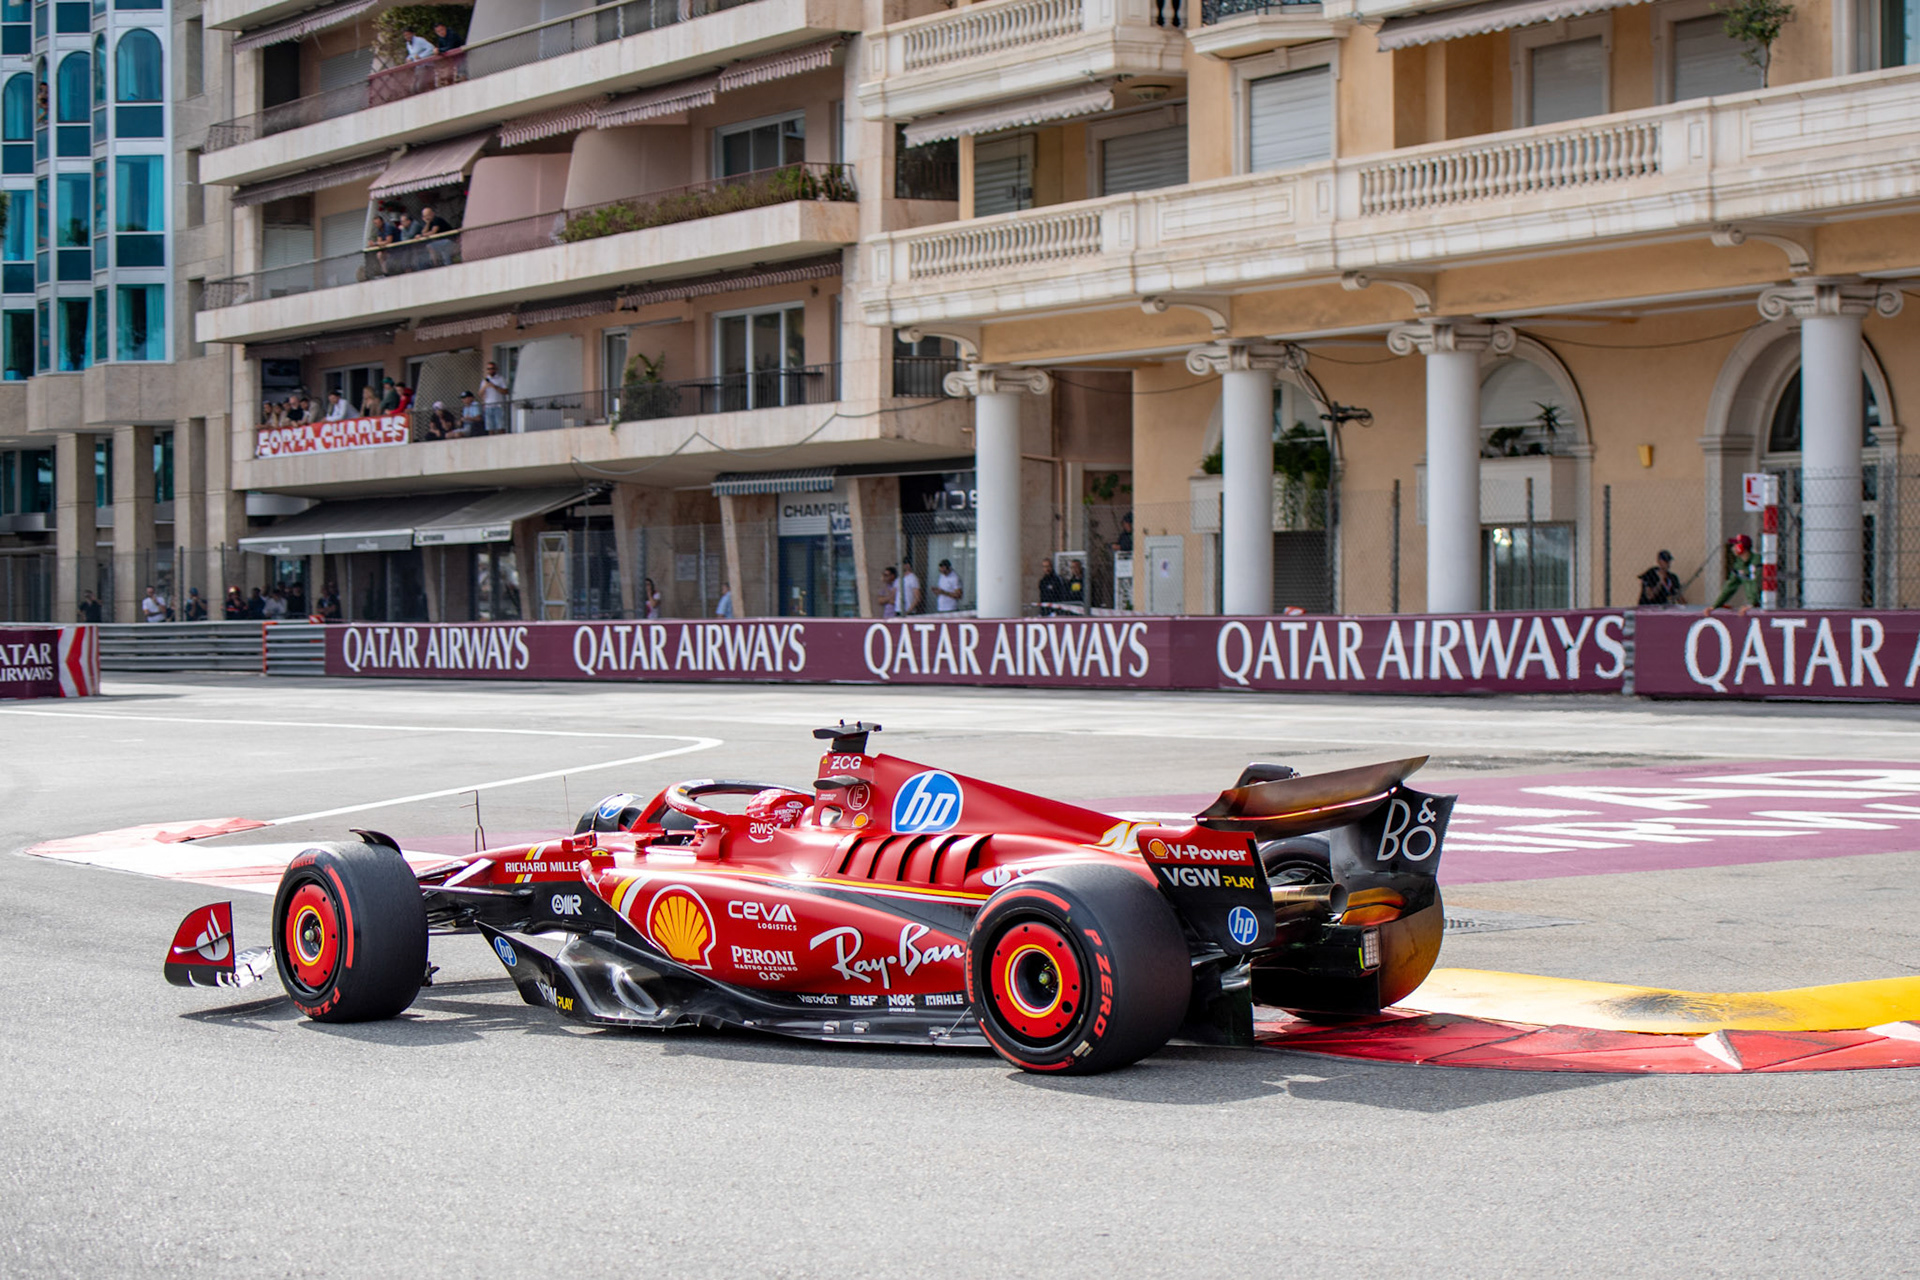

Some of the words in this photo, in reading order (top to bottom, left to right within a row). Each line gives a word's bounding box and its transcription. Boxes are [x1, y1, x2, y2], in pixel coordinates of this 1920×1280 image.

[257, 427, 317, 456] FORZA
[320, 415, 407, 449] CHARLES
[343, 627, 420, 672] QATAR
[424, 627, 530, 671] AIRWAYS
[573, 625, 669, 676] QATAR
[675, 624, 807, 672] AIRWAYS
[864, 623, 982, 680] QATAR
[989, 621, 1149, 679] AIRWAYS
[1217, 621, 1365, 685] QATAR
[1376, 615, 1627, 681] AIRWAYS
[1684, 617, 1889, 692] QATAR
[0, 666, 54, 682] IRWAYS
[830, 755, 863, 770] ZCG
[898, 771, 958, 833] hp
[749, 822, 774, 834] aws
[1167, 843, 1247, 862] V-Power
[505, 861, 547, 872] RICHARD
[549, 861, 580, 872] MILLE
[1161, 867, 1221, 887] VGW
[1222, 875, 1255, 890] PLAY
[757, 923, 797, 931] LOGISTICS
[1232, 907, 1256, 945] hp
[498, 938, 515, 967] hp
[730, 945, 797, 966] PERONI
[734, 963, 761, 971] NASTRO
[557, 997, 574, 1011] PLAY
[850, 995, 878, 1006] SKF
[888, 994, 915, 1006] NGK
[925, 993, 964, 1006] MAHLE
[1093, 951, 1114, 1038] ZERO
